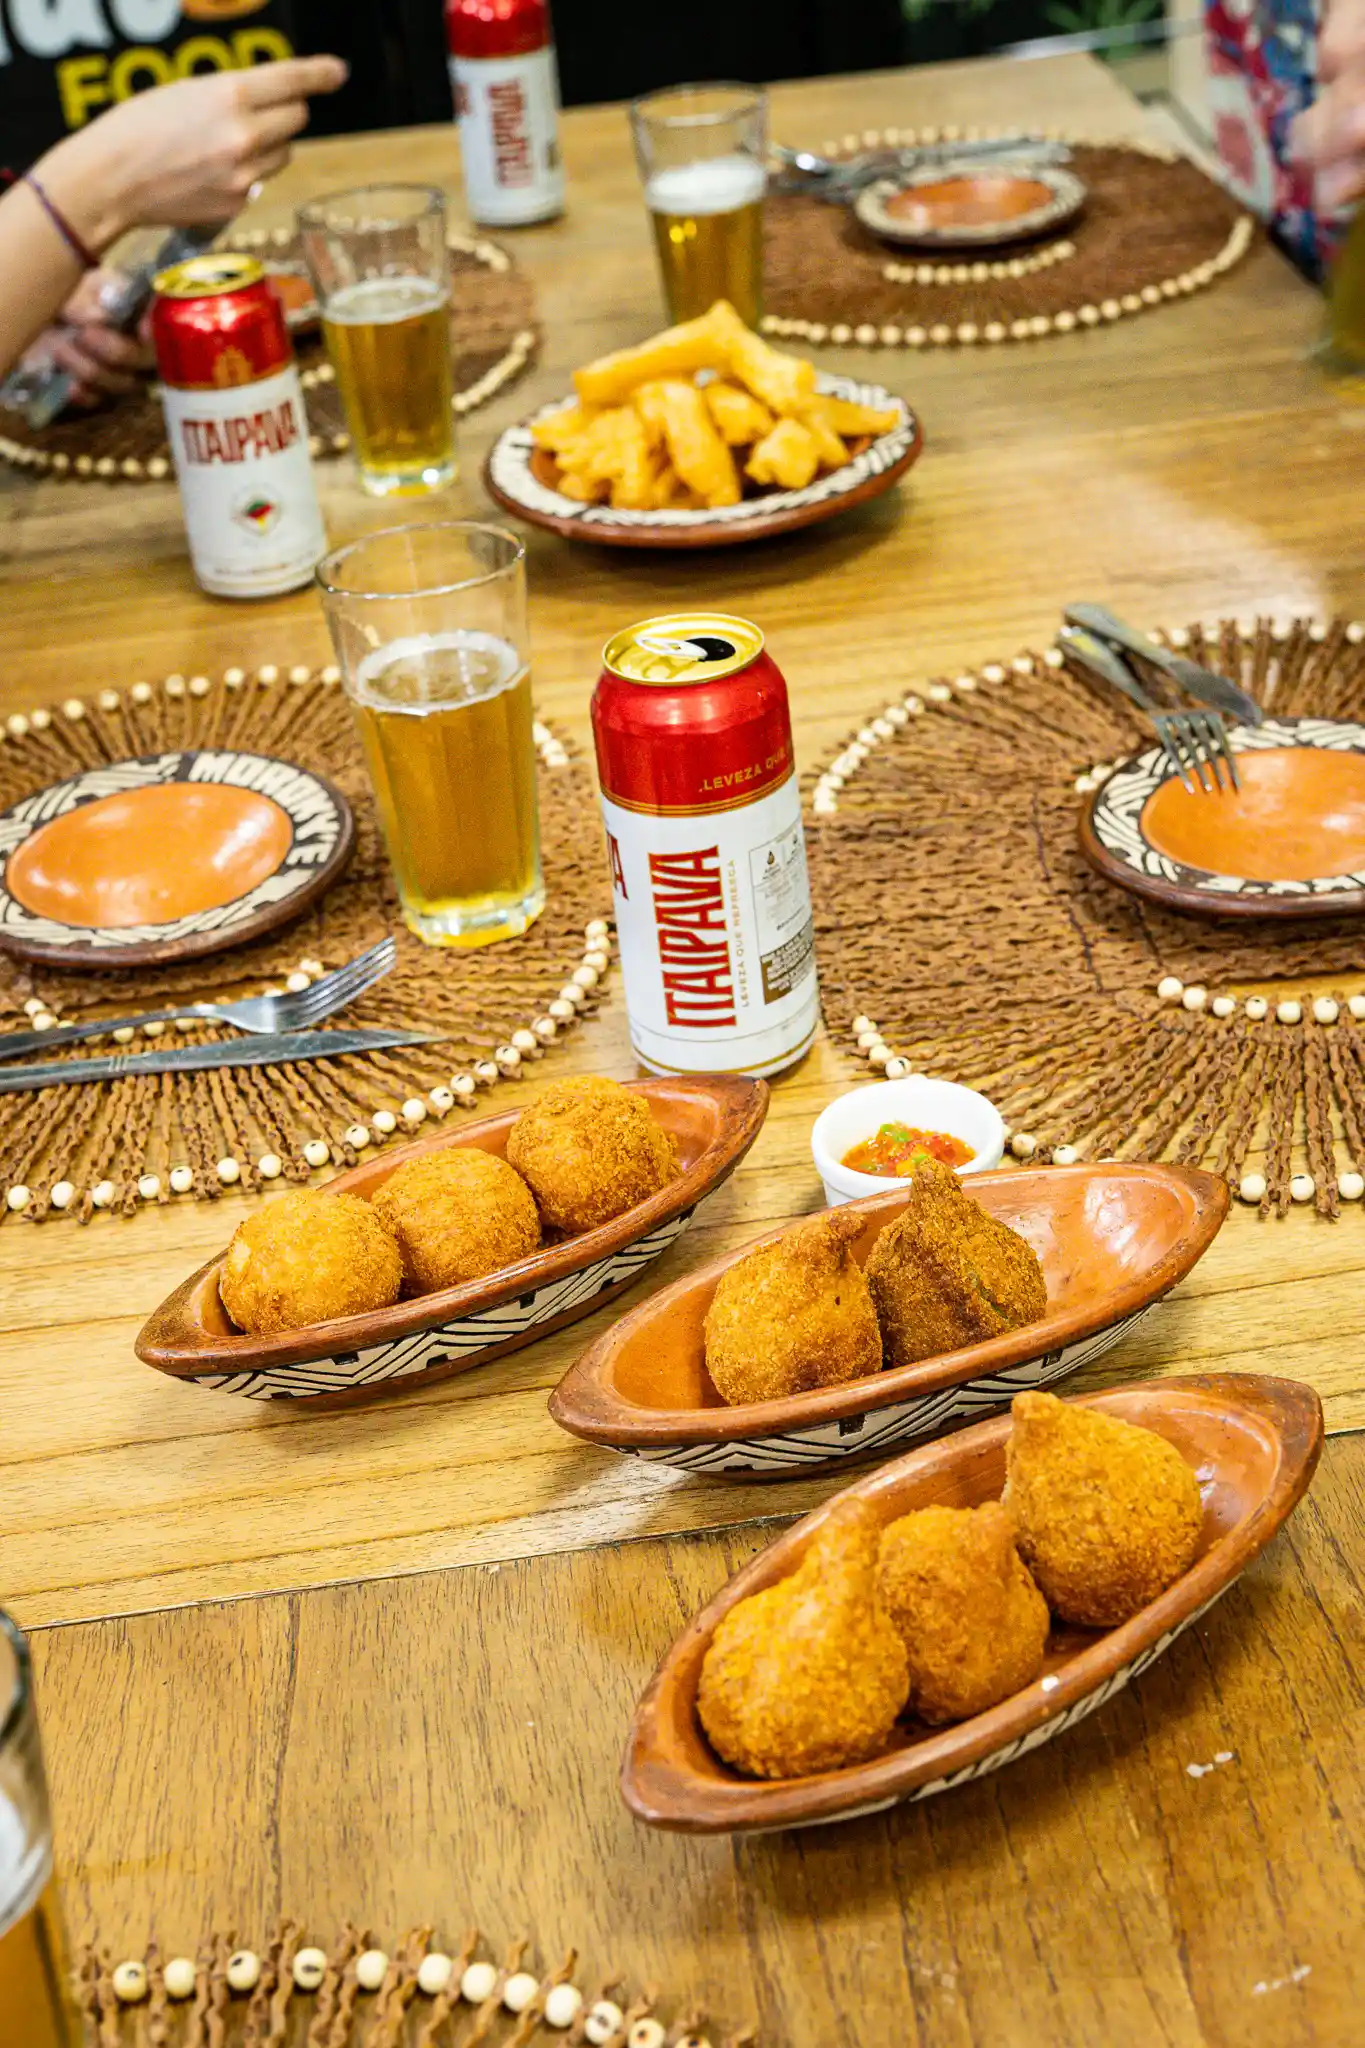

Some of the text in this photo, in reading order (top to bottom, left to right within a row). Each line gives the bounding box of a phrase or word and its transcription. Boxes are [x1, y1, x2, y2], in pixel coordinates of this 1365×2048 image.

[182, 401, 297, 464] ITAIPAVA
[648, 845, 737, 1027] ITAIPAVA
[735, 933, 744, 956] QUE
[737, 961, 749, 1007] LEVEZA
